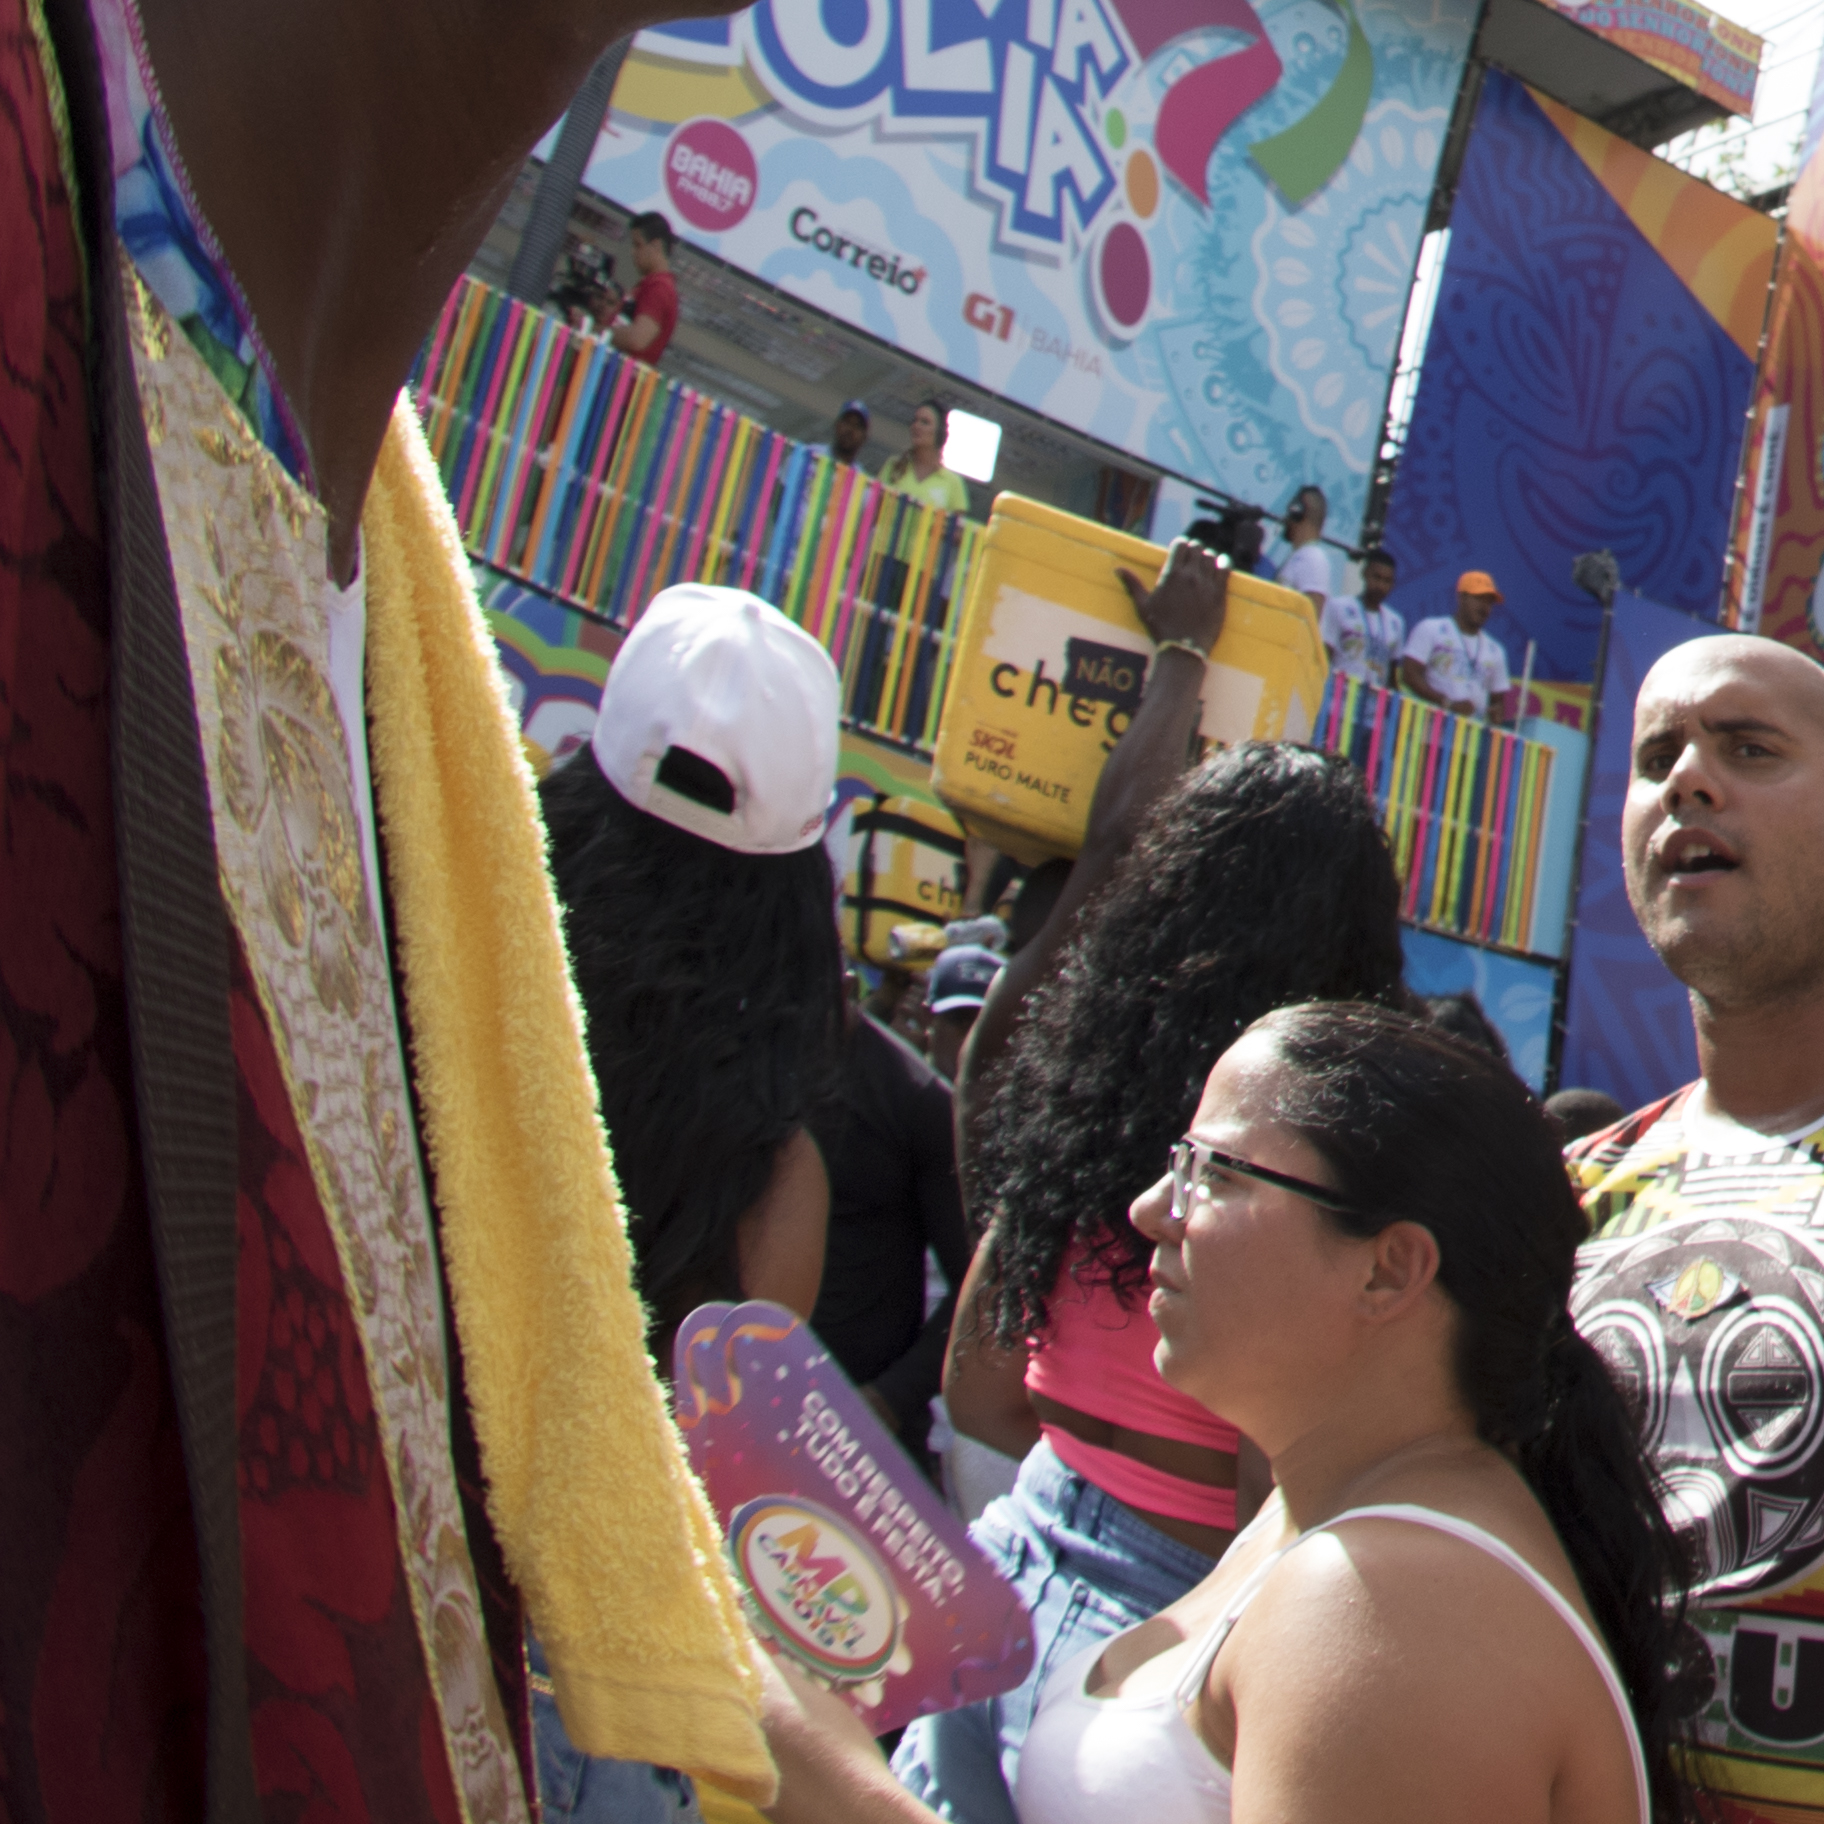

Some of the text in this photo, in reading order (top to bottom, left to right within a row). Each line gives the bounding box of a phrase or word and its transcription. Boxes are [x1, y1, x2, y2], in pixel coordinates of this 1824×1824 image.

[671, 143, 753, 207] BAHIA
[789, 206, 921, 296] Correio
[963, 291, 1104, 378] G1 BAHIA
[990, 659, 1136, 754] cheg
[1076, 656, 1135, 693] NÃO
[964, 752, 1073, 804] PURO MALTE
[794, 1414, 860, 1500] TUDO
[803, 1389, 862, 1461] COM
[776, 1522, 870, 1615] MP
